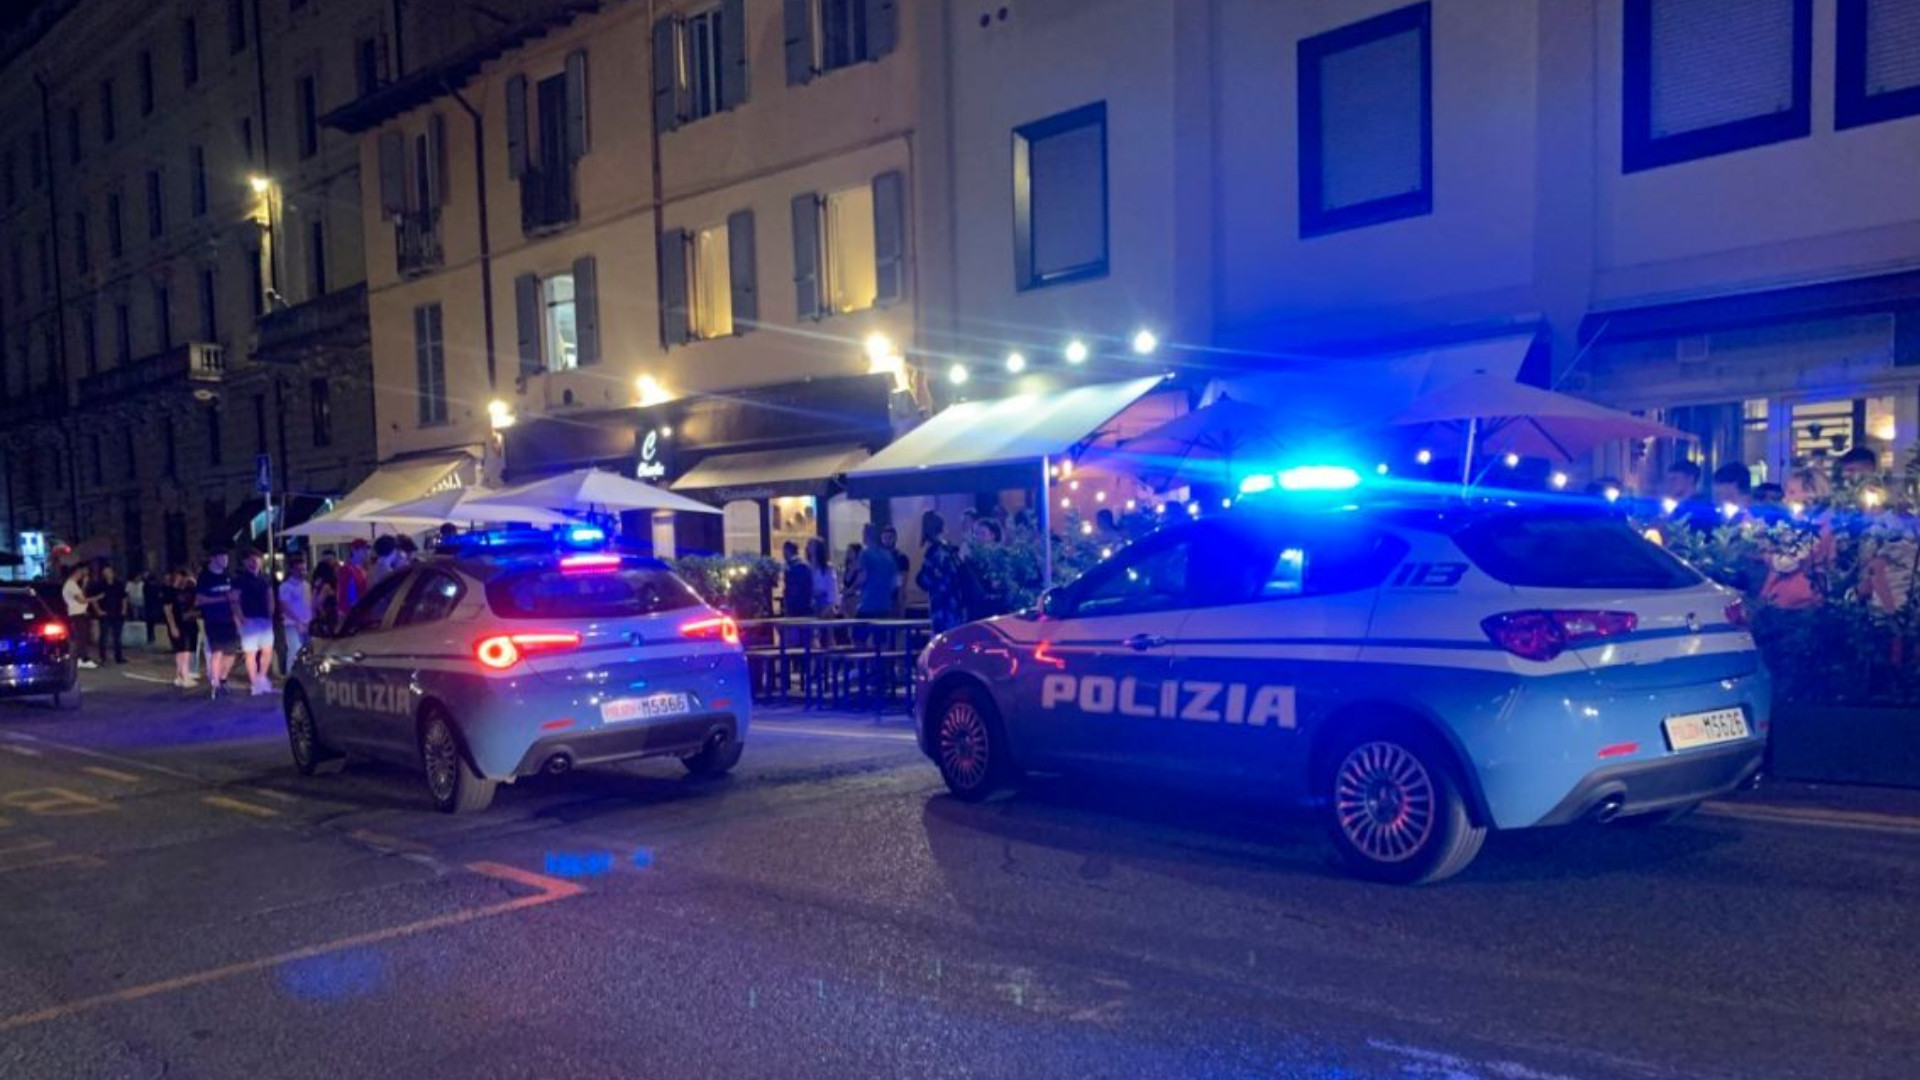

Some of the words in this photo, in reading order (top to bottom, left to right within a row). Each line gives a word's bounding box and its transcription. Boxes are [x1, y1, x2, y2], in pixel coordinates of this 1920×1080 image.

[1390, 562, 1470, 587] 113
[325, 680, 411, 715] POLIZIA
[1042, 674, 1297, 729] POLIZIA
